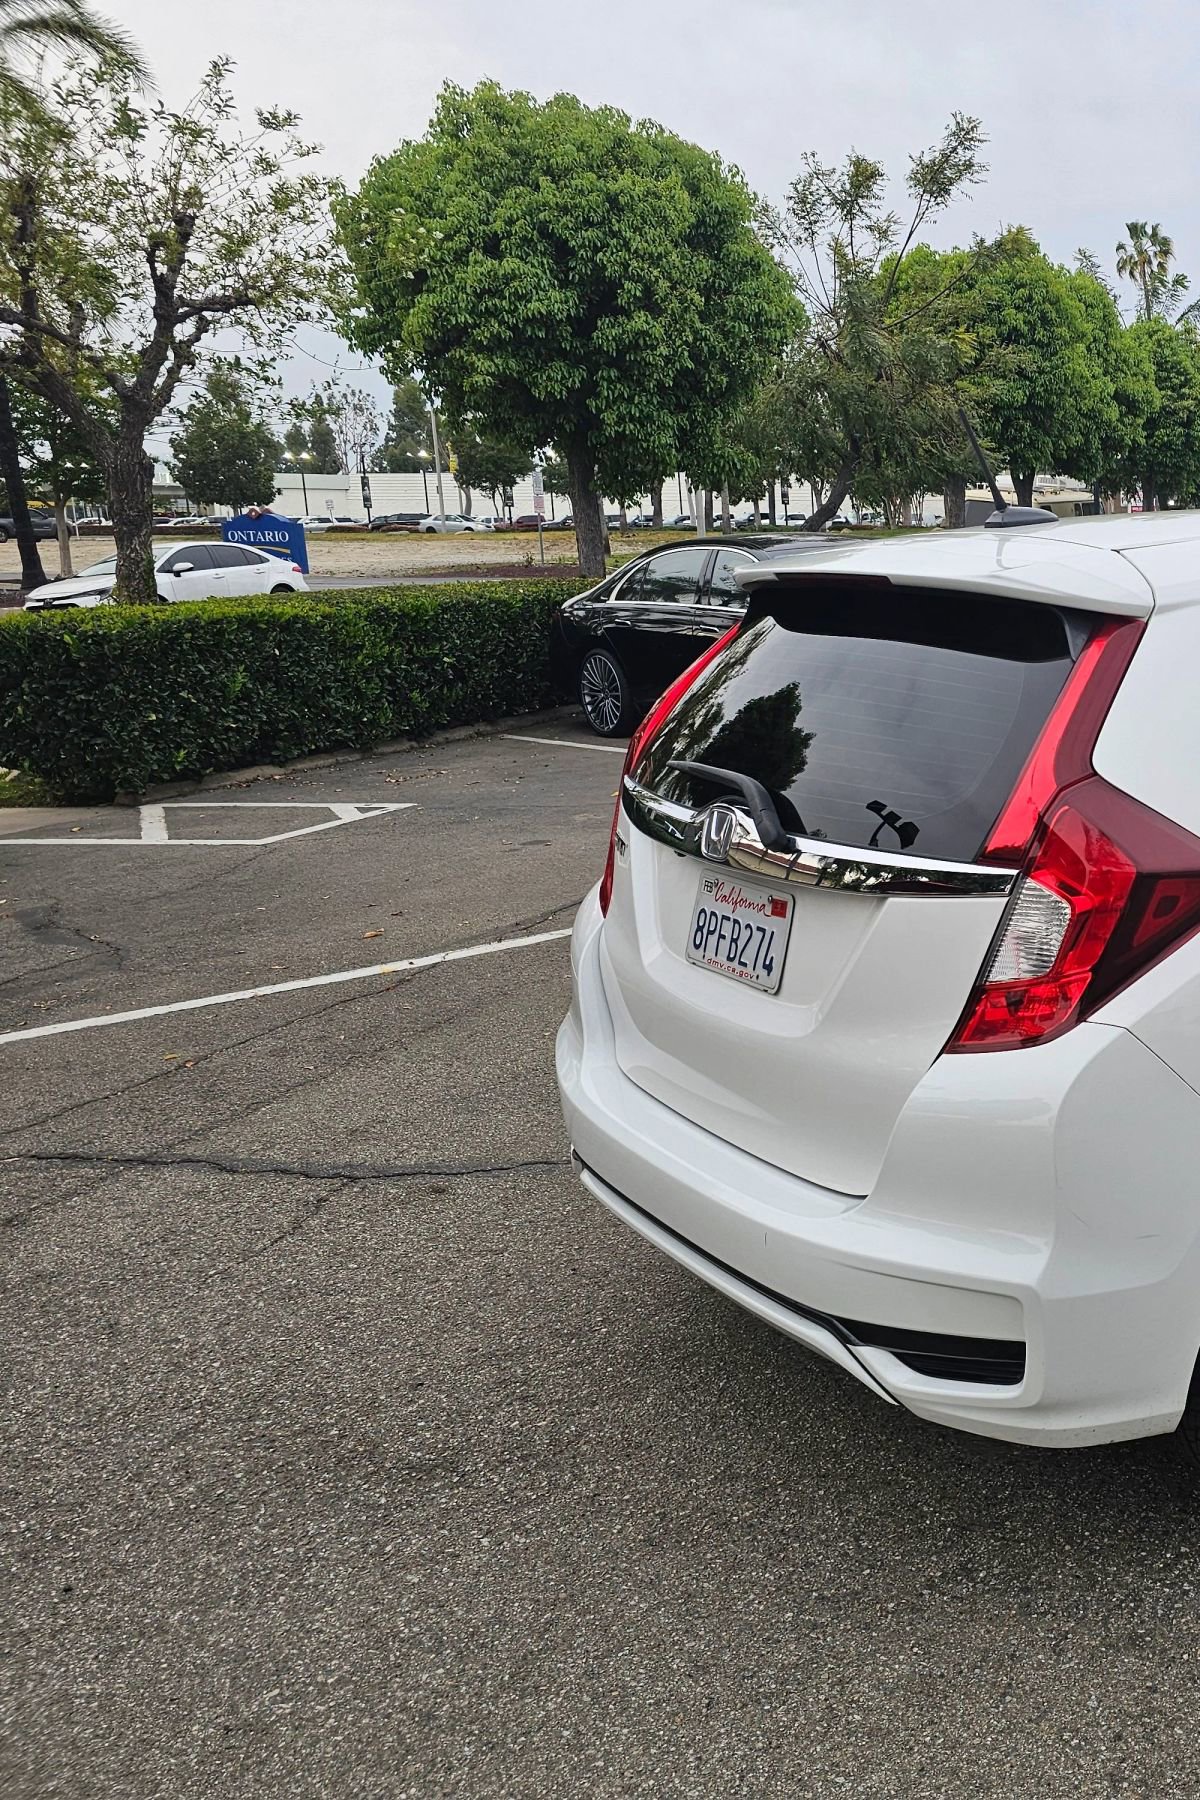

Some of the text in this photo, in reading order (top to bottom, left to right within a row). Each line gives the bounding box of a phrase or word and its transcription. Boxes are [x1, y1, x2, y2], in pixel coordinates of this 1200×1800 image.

[228, 530, 289, 543] ONTARIO
[714, 881, 772, 918] California
[692, 907, 775, 977] 8PFB274
[706, 957, 755, 979] dmv.ca.gov
